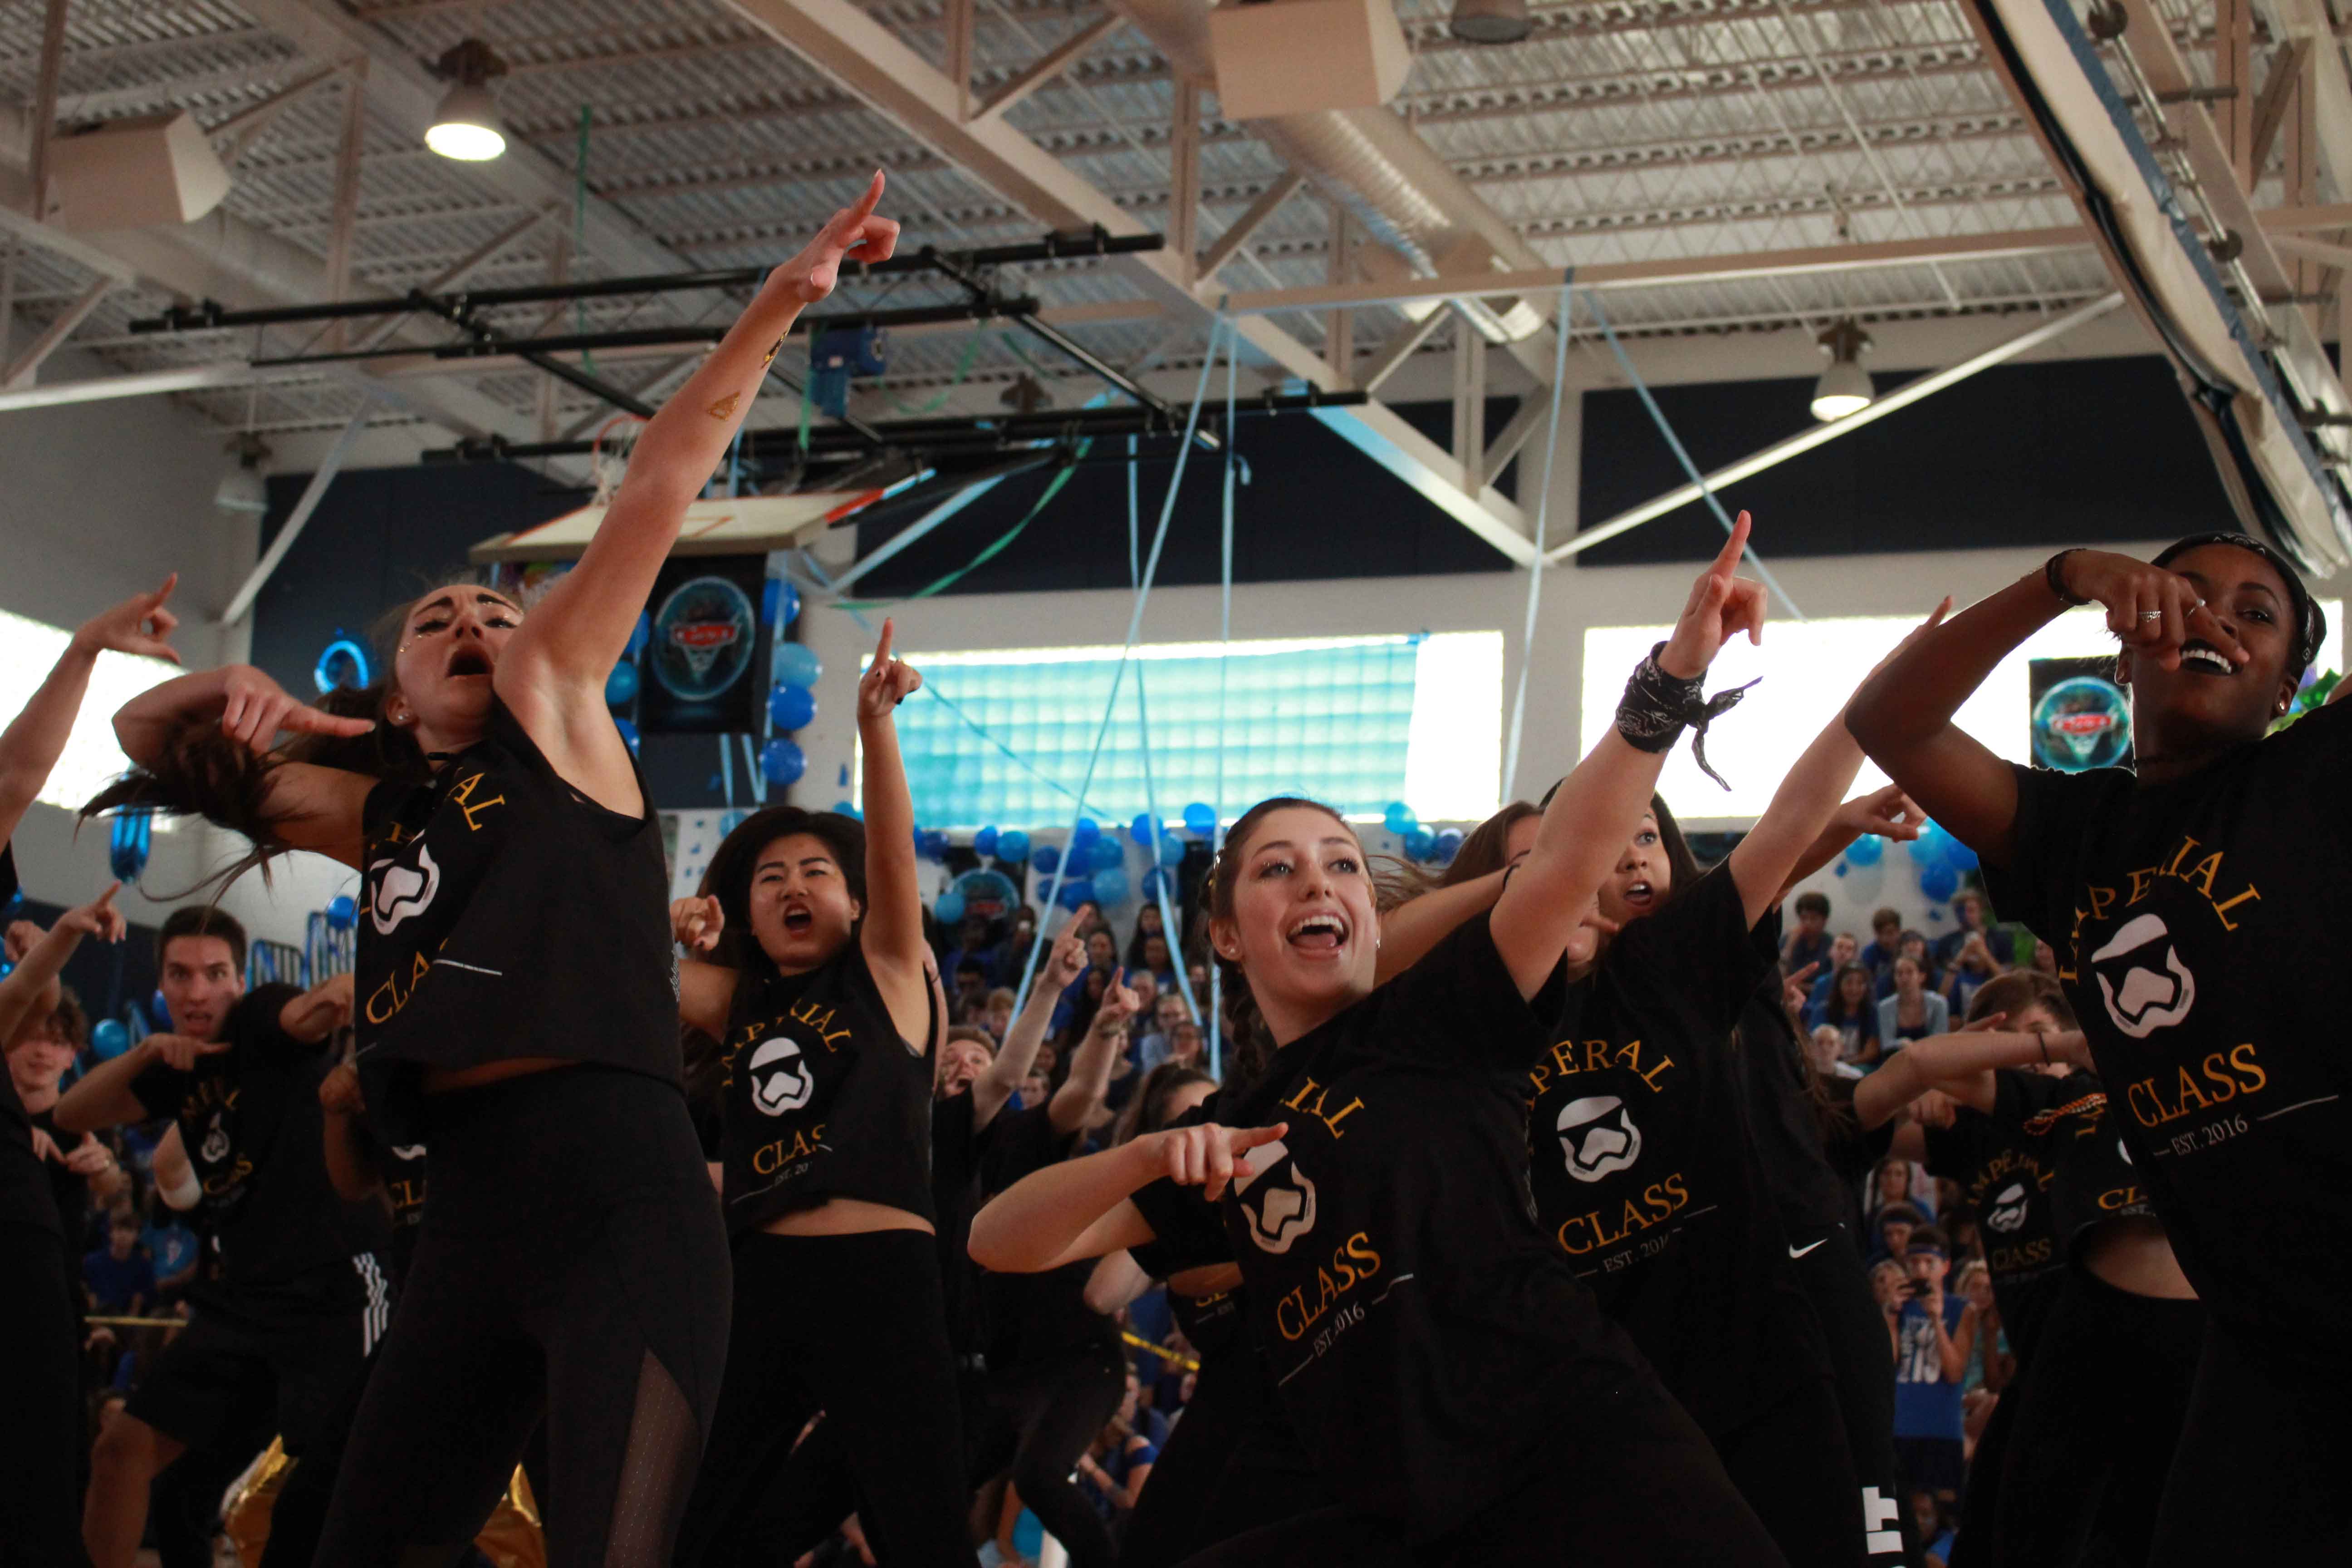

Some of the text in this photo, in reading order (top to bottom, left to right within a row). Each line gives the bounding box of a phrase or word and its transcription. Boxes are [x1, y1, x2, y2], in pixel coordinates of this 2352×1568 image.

[2127, 1044, 2267, 1129] CLASS
[2171, 1112, 2249, 1156] EST. 2016
[1557, 1173, 1689, 1255] CLASS
[1277, 1231, 1381, 1341] CLASS
[1602, 1248, 1641, 1273] EST.
